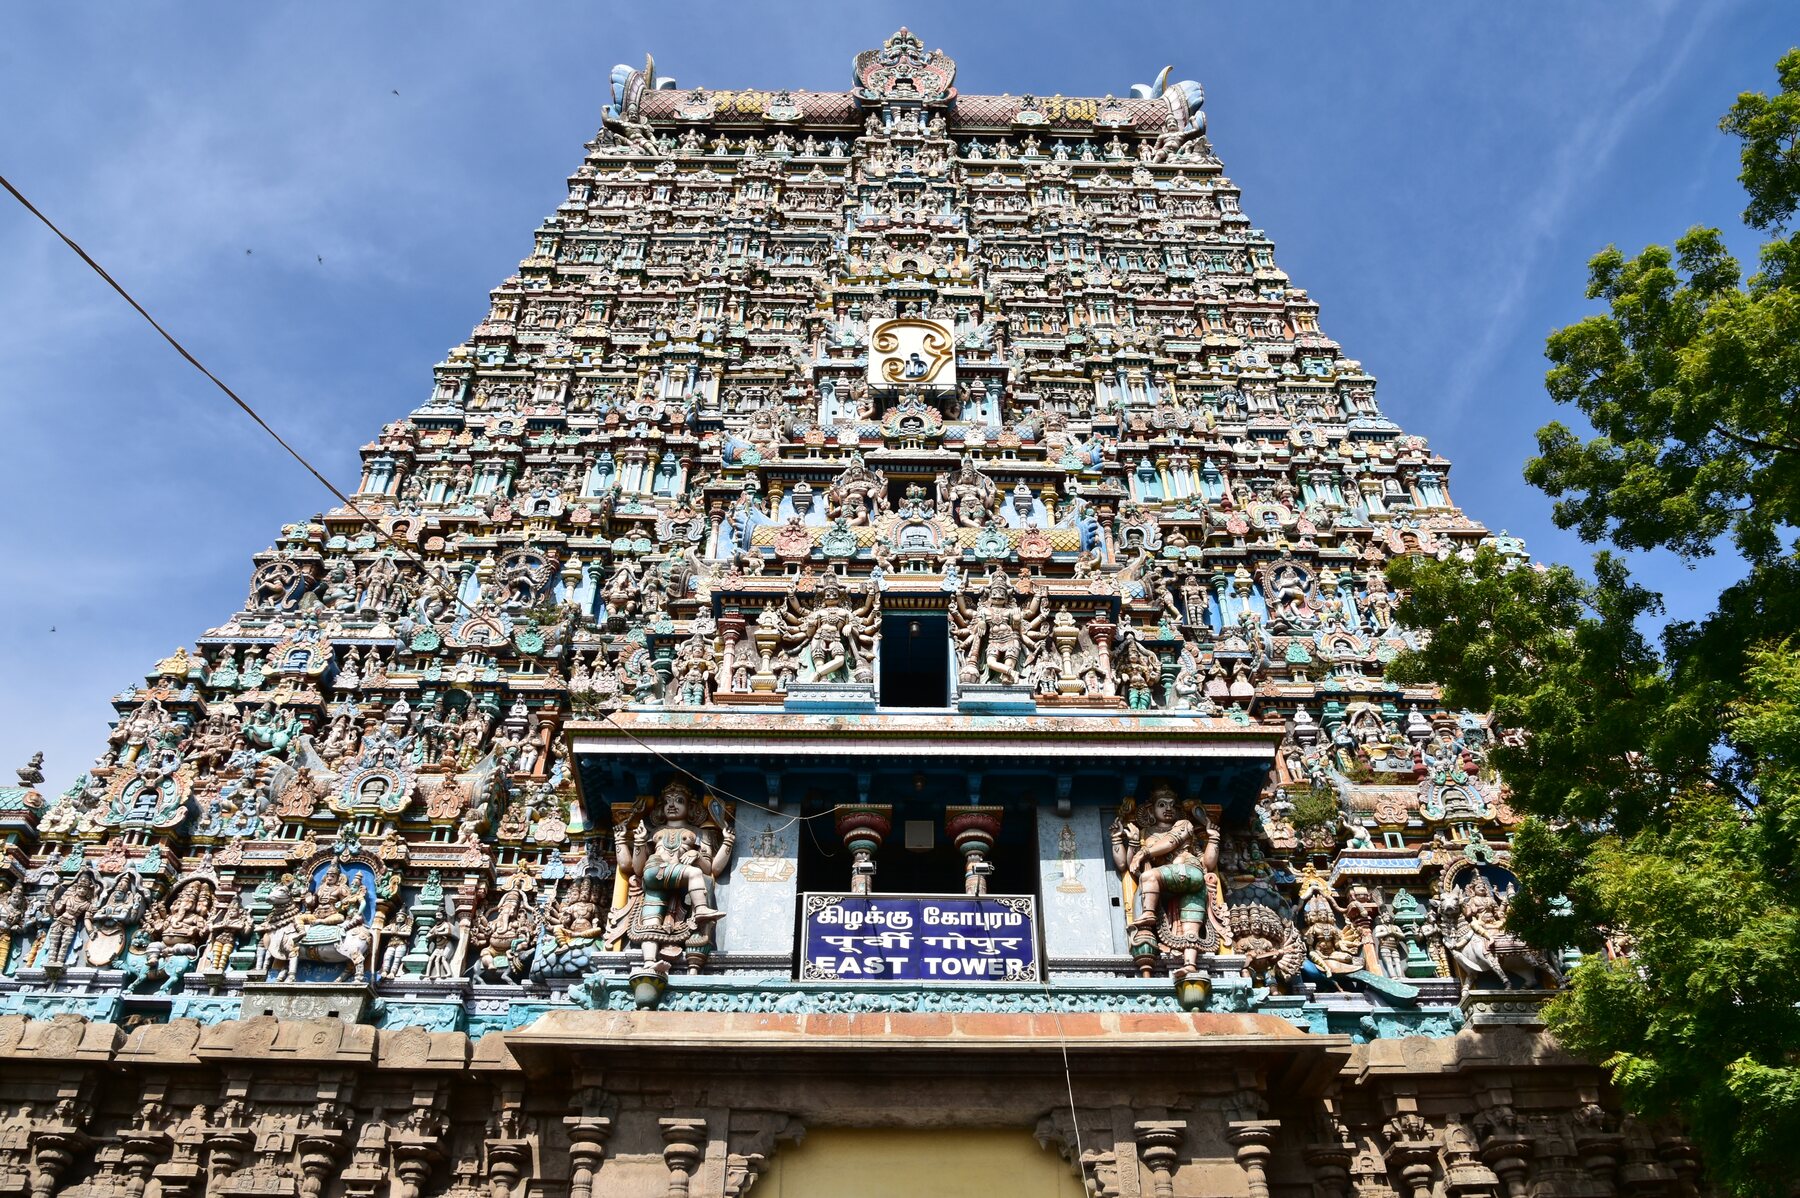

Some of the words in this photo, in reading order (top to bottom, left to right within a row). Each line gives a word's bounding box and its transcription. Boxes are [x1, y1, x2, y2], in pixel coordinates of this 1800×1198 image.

[817, 905, 913, 930] கிழக்கு
[923, 906, 1022, 931] கோபுரம்
[821, 932, 914, 954] पूर्वी
[921, 932, 1022, 955] गोपुर
[816, 957, 908, 974] EAST
[924, 957, 1023, 975] TOWER
